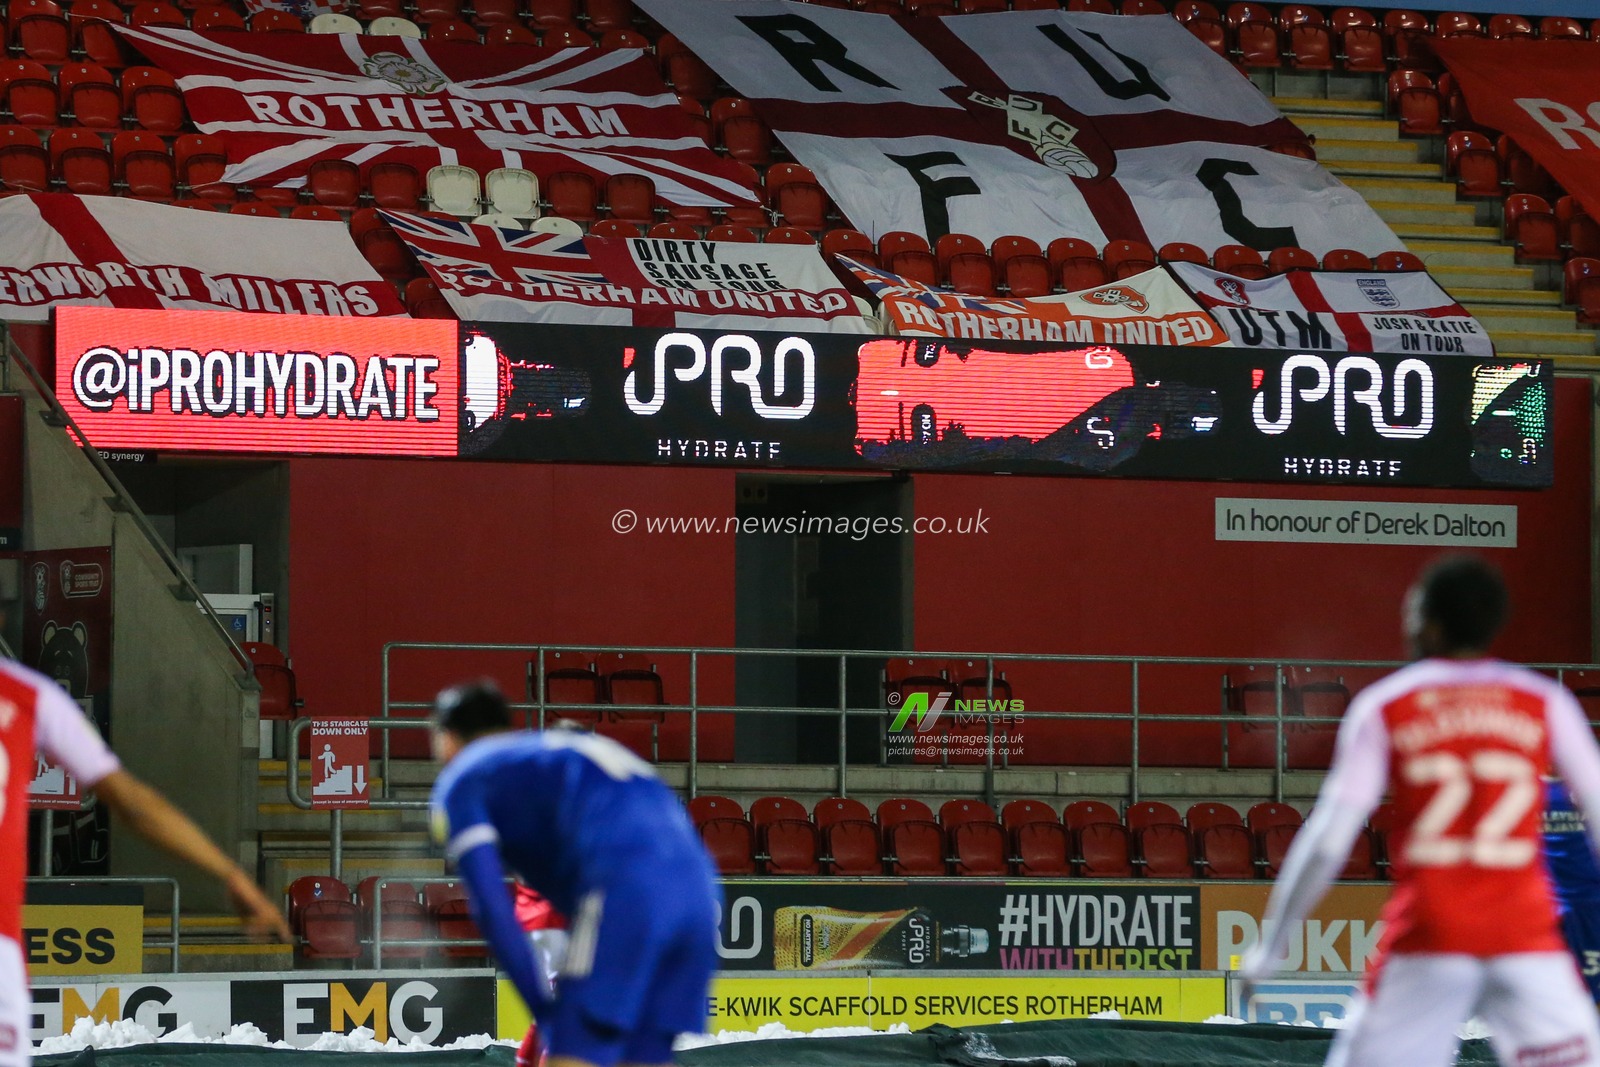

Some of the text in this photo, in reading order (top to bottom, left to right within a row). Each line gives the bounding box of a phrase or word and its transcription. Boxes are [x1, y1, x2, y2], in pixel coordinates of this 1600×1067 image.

[735, 14, 899, 92] R
[248, 93, 631, 137] ROTHERHAM
[1513, 98, 1600, 149] R
[633, 238, 716, 264] DIRTY
[643, 261, 776, 280] SAUSAGE
[200, 274, 380, 317] MILLERS
[432, 267, 849, 314] ROTHERHAM UNITED
[895, 301, 1214, 347] ROTHERHAM UNITED
[1228, 308, 1333, 349] UTM
[1374, 317, 1477, 334] JOSH & KATIE
[1401, 333, 1466, 353] ON TOUR
[72, 346, 440, 420] @iPROHYDRATE
[111, 452, 145, 462] synergy
[1226, 508, 1506, 538] In honour of Derek Dalton
[312, 728, 367, 736] DOWN ONLY
[1405, 752, 1538, 870] 22
[998, 894, 1193, 947] #HYDRATE
[22, 927, 115, 964] ESS
[283, 980, 444, 1047] EMG
[788, 996, 908, 1017] SCAFFOLD
[913, 995, 1020, 1016] SERVICES
[1025, 995, 1163, 1016] ROTHERHAM
